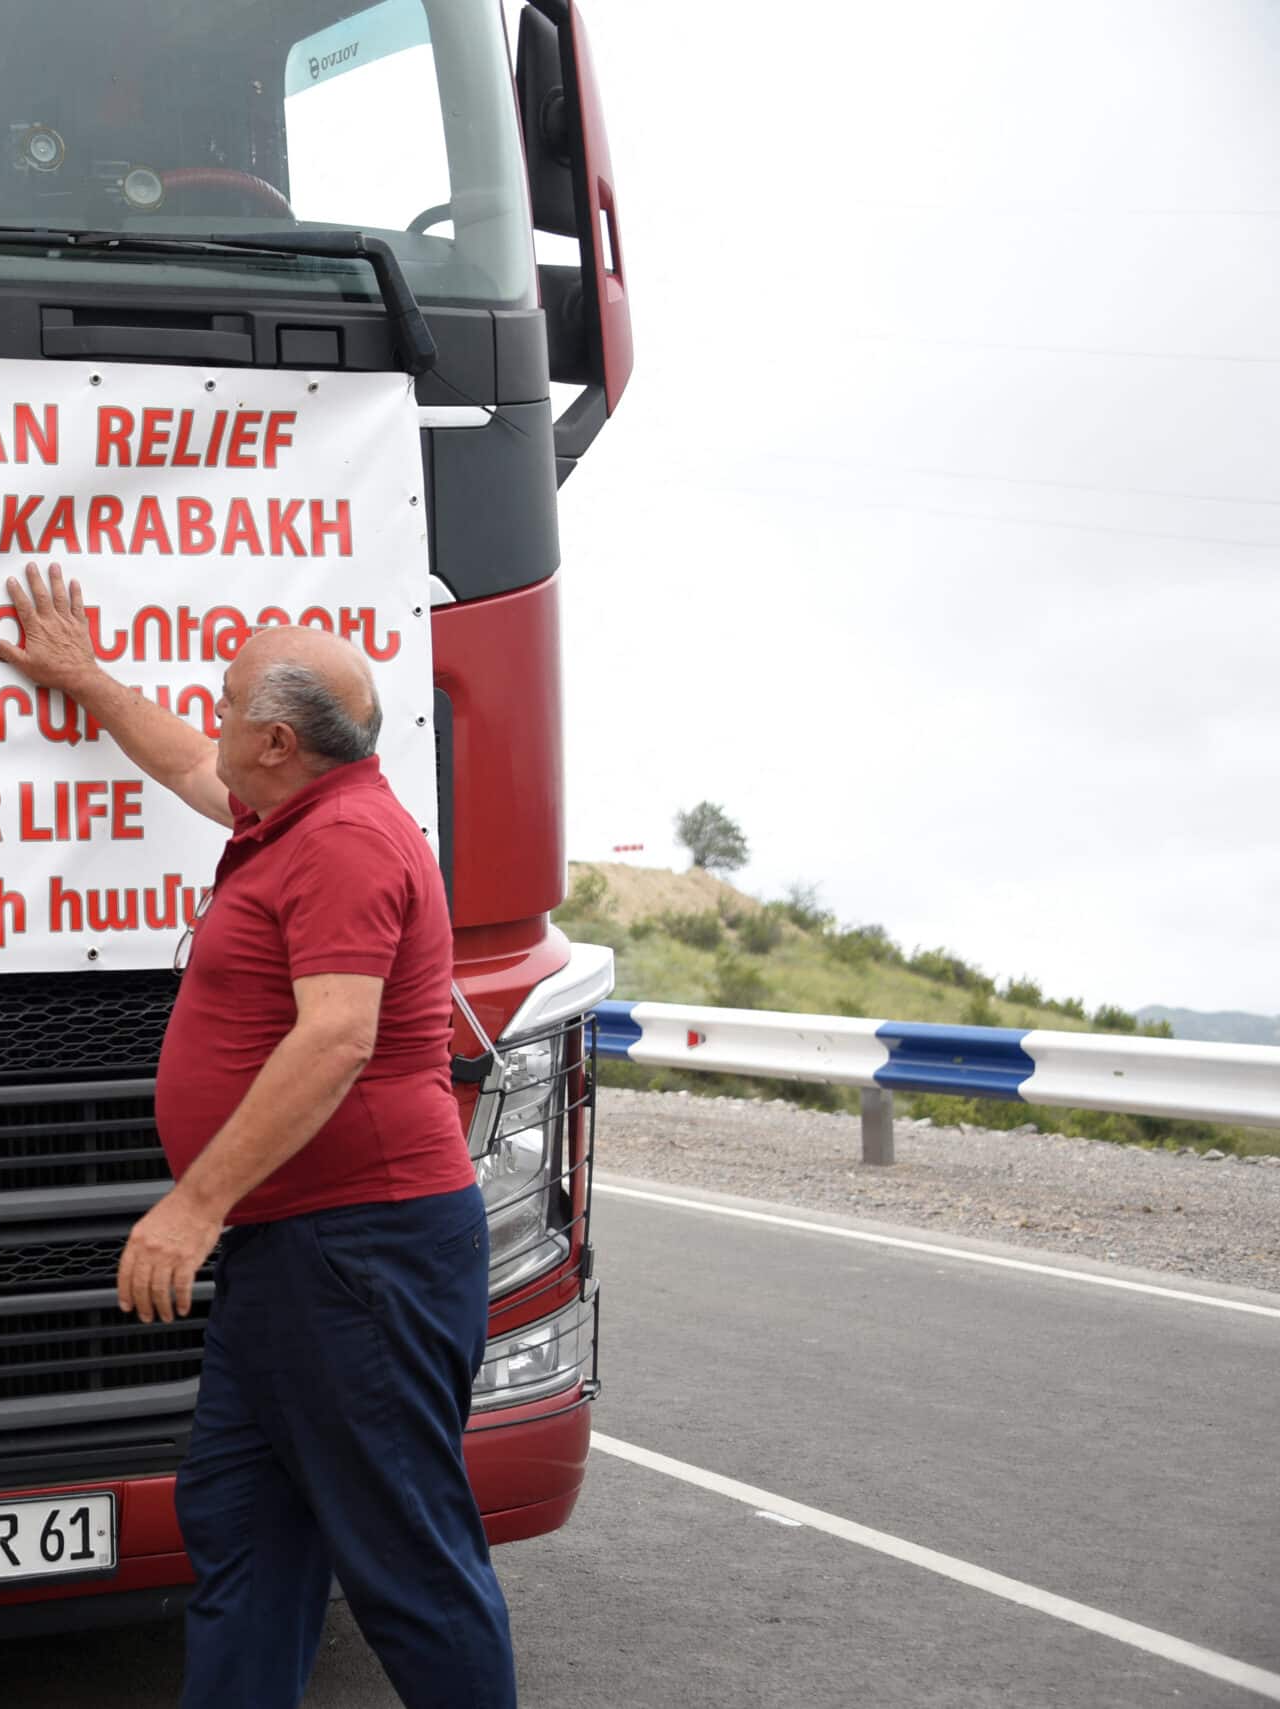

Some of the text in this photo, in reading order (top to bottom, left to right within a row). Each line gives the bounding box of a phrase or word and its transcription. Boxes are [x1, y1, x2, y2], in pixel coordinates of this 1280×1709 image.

[95, 405, 298, 470] RELIEF
[18, 779, 146, 843] LIFE
[39, 1506, 96, 1564] 61
